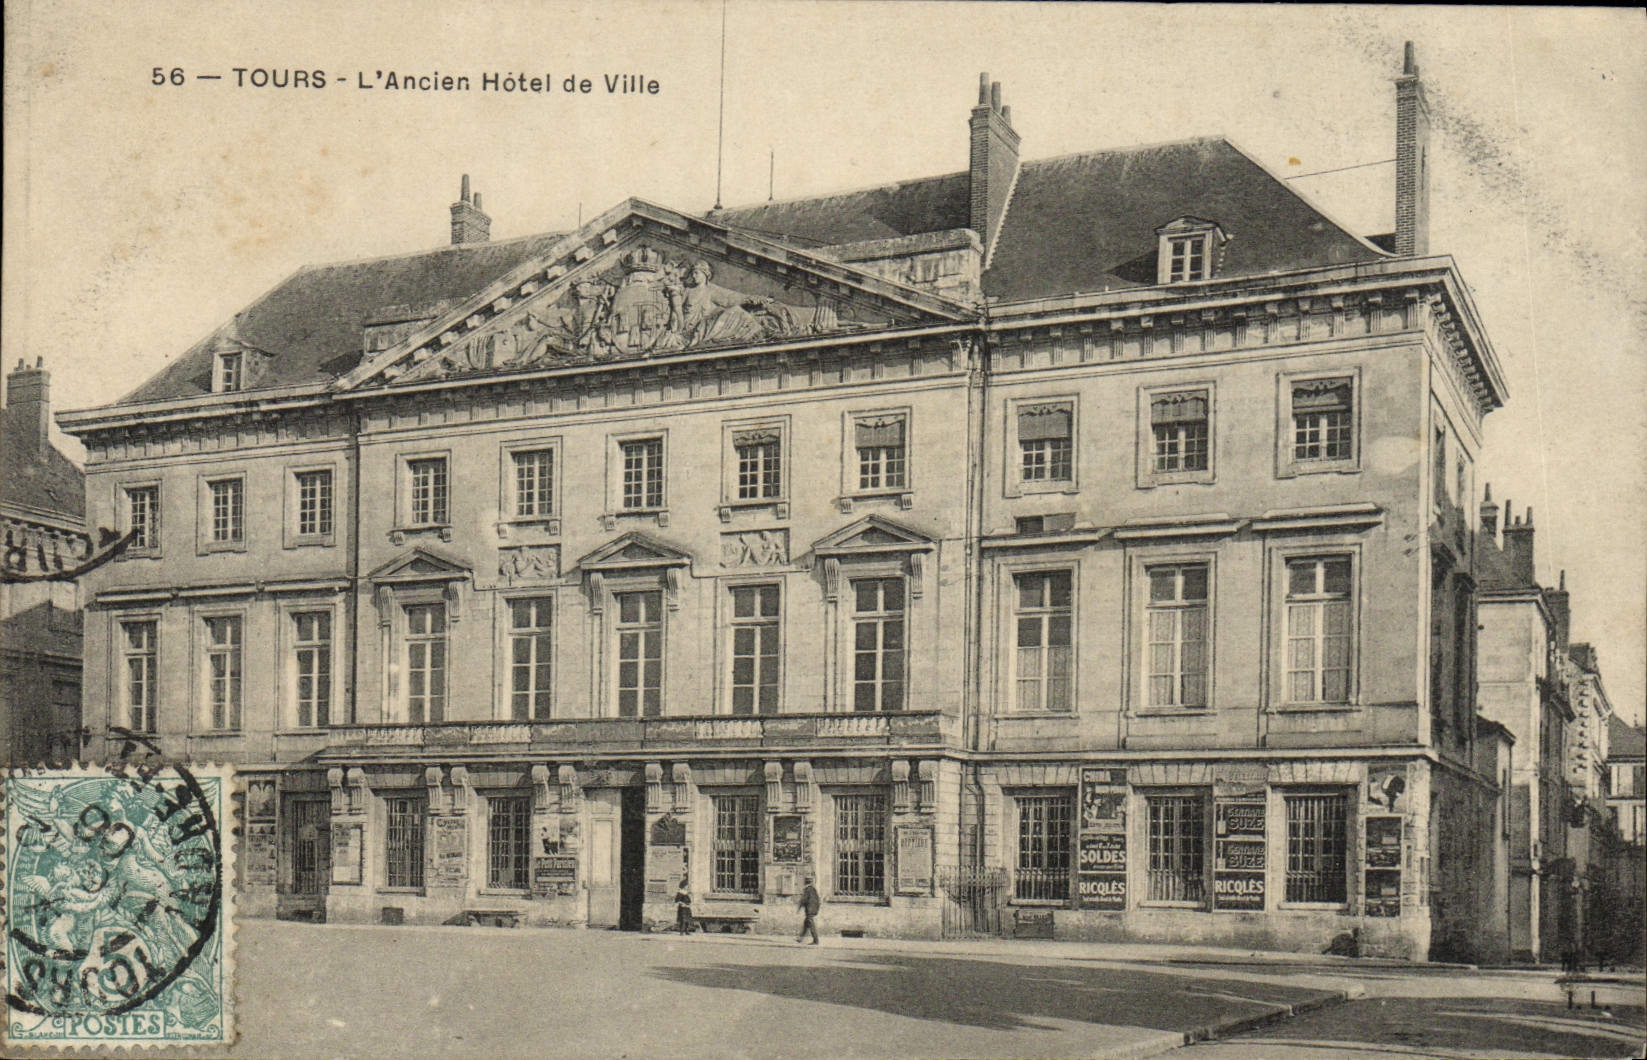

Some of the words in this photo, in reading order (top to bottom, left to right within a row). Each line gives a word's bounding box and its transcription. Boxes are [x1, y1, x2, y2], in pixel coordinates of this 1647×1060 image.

[1228, 817, 1265, 830] SUZE
[1080, 850, 1126, 864] SOLDES
[1228, 855, 1265, 868] SUZE
[1079, 880, 1126, 896] RICQLÈS
[1214, 877, 1265, 896] RICQLÈS
[68, 1013, 161, 1036] POSTES
